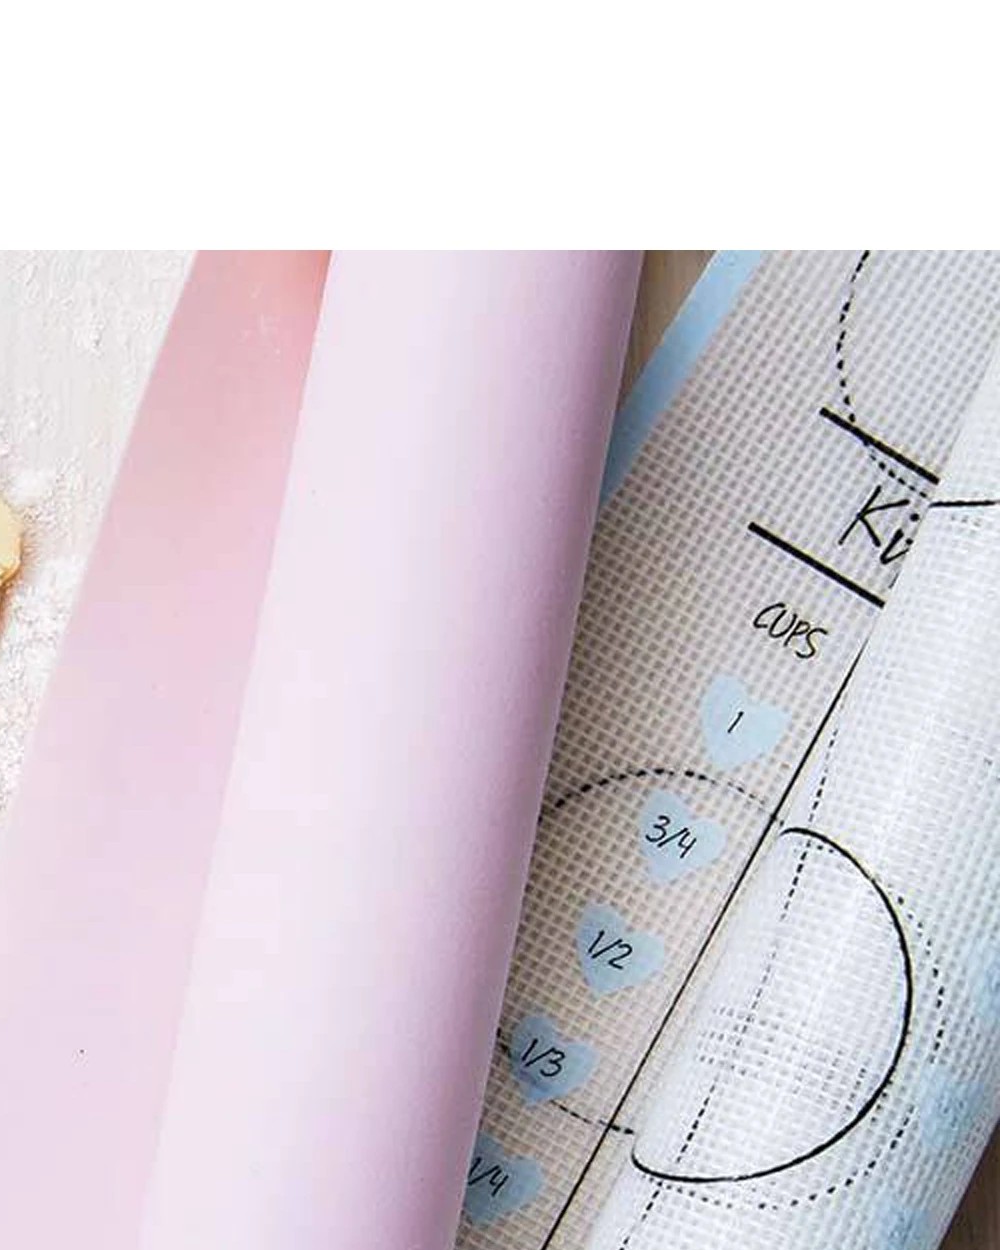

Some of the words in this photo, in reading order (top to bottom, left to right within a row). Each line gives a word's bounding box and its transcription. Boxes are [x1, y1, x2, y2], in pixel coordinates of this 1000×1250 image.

[838, 485, 920, 565] Ki
[753, 602, 829, 659] CUPS
[645, 815, 697, 859] 3/4
[588, 930, 633, 970] 1/2
[521, 1038, 566, 1077] 1/3
